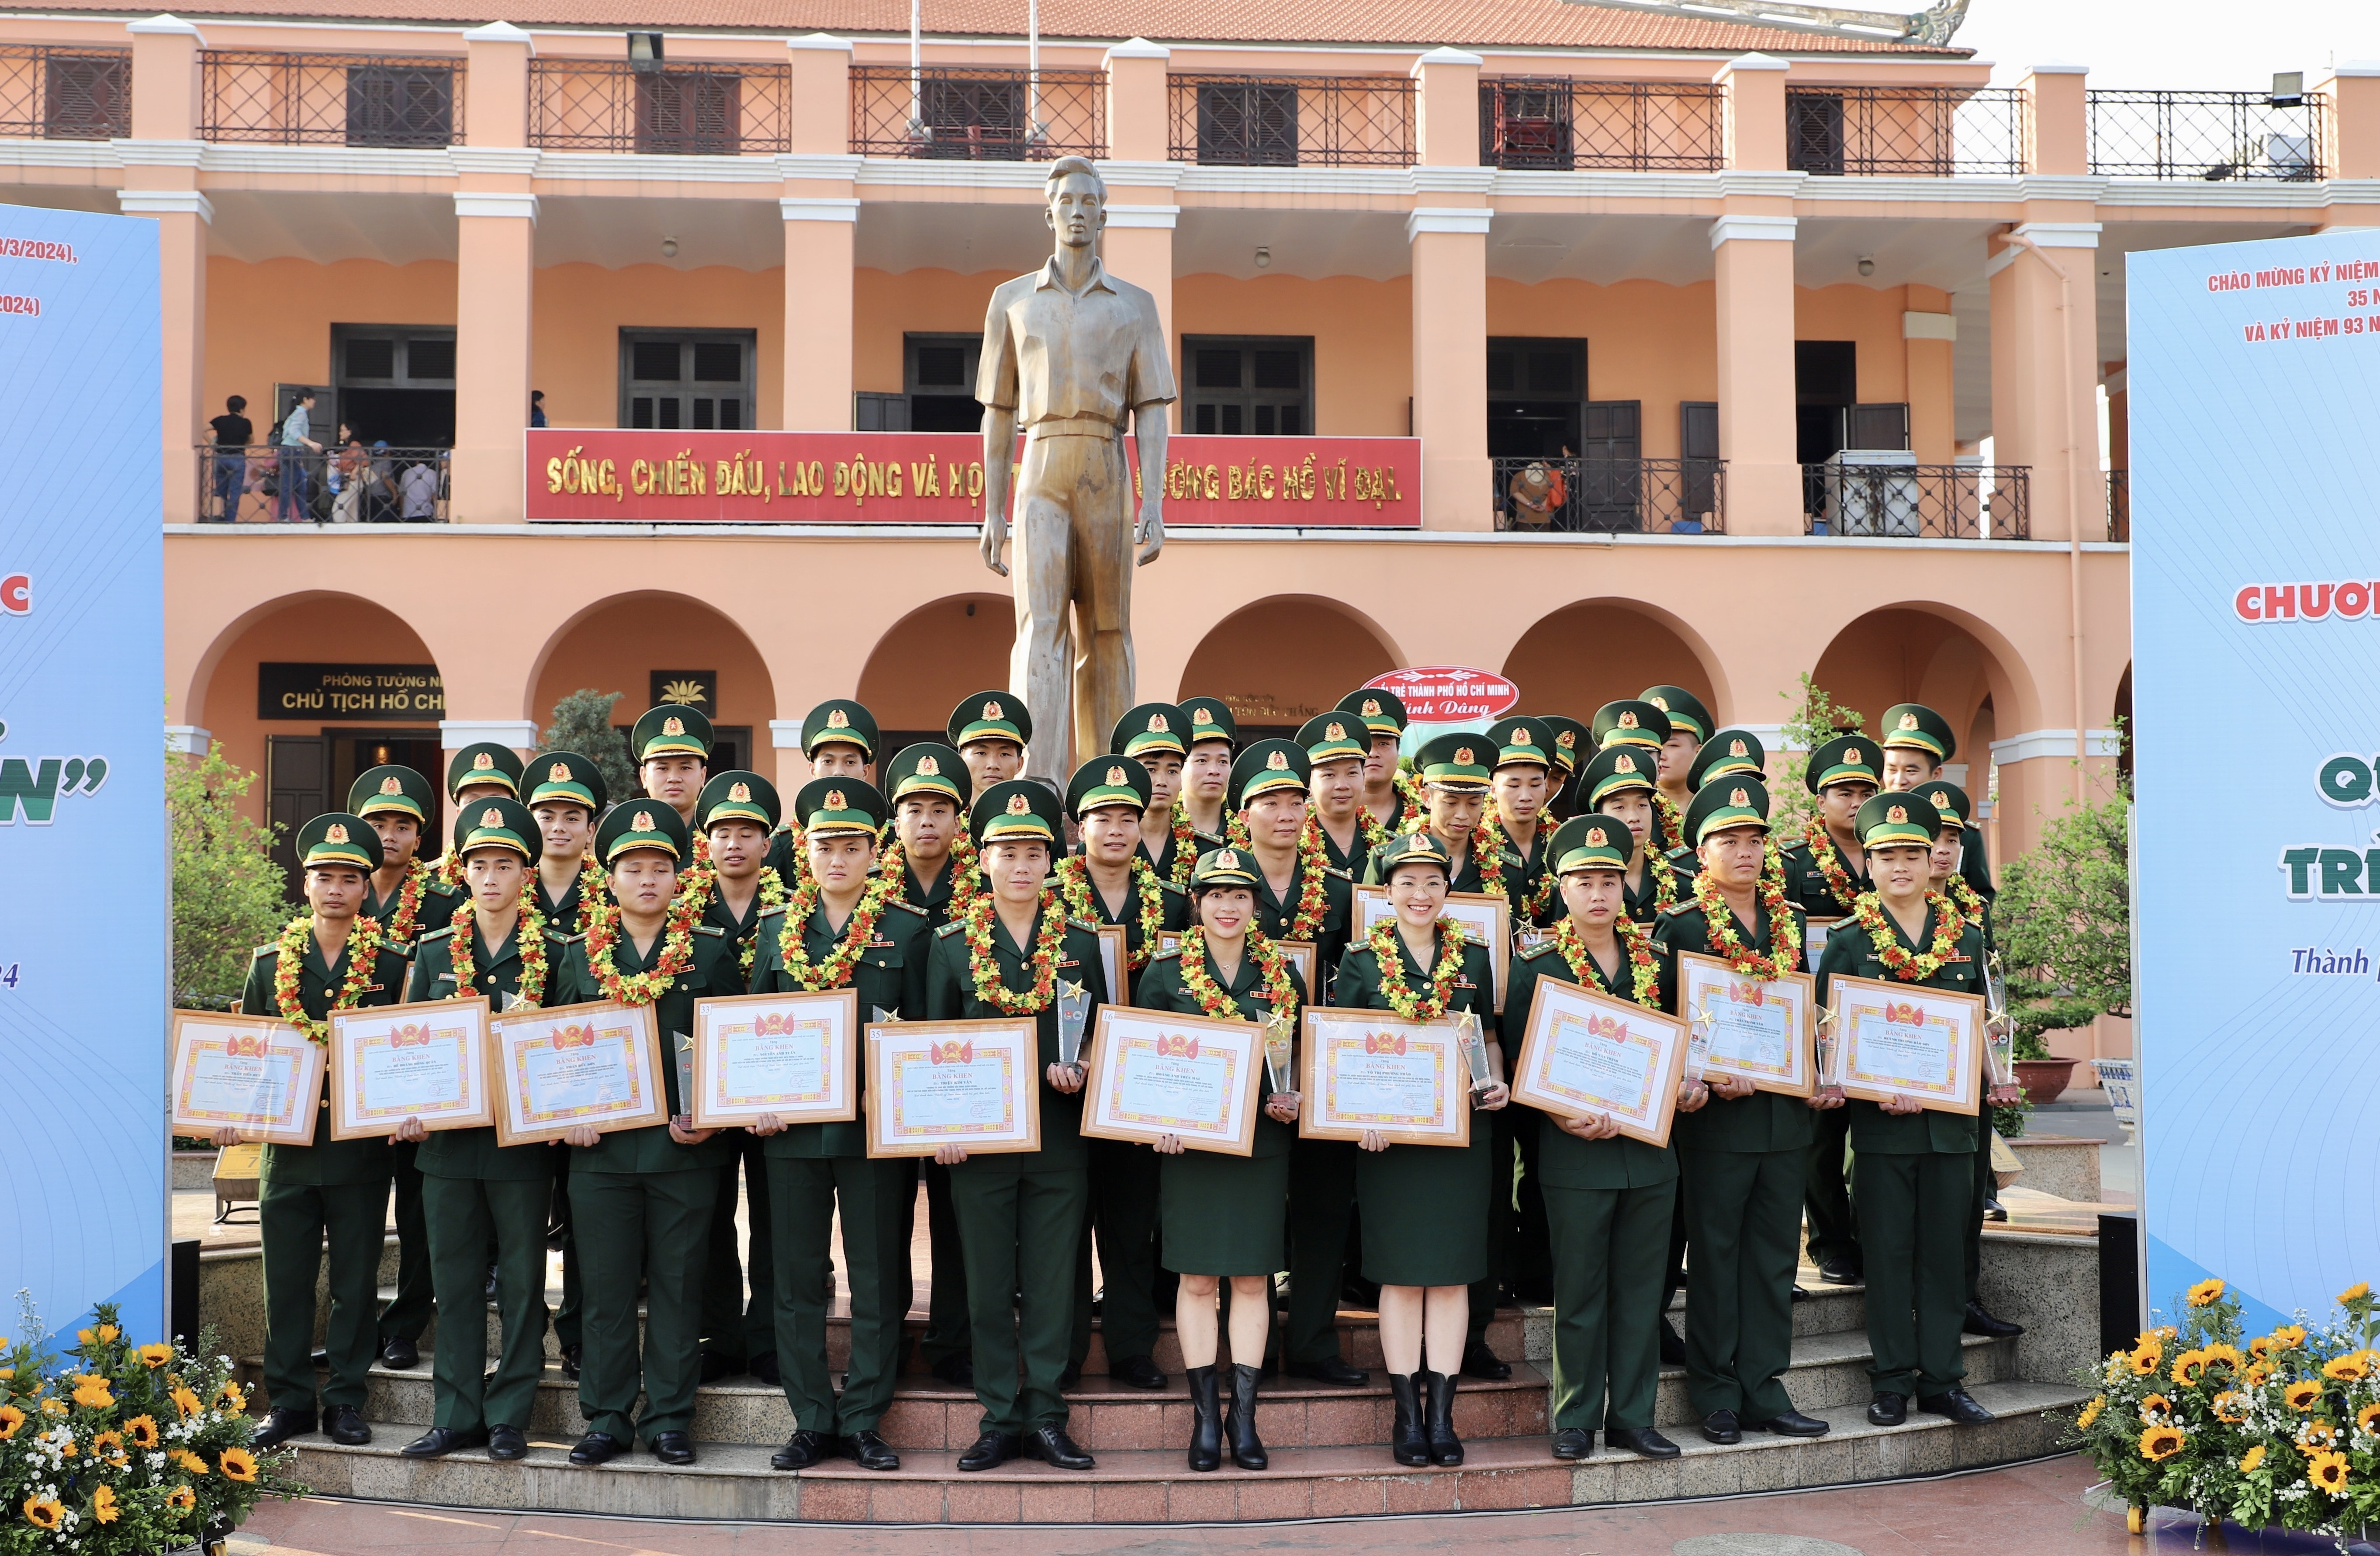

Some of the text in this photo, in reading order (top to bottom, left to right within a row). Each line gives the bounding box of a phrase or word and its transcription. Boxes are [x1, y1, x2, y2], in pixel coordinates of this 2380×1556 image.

[0, 238, 77, 263] /3/2024),
[2209, 260, 2379, 292] CHÀO MỪNG KỶ NIỆM
[0, 295, 40, 316] 024)
[2348, 290, 2367, 307] 35
[2244, 322, 2265, 342] VÀ
[2271, 317, 2290, 340] KỶ
[2296, 317, 2338, 340] NIỆM
[2344, 318, 2363, 334] 93
[547, 445, 623, 502] SỐNG,
[631, 448, 706, 496] CHIẾN
[716, 449, 771, 503] ĐẤU,
[779, 461, 824, 497] LAO
[834, 453, 903, 506] ĐỘNG
[911, 454, 941, 497] VÀ
[949, 461, 983, 507] HỌ
[1228, 457, 1275, 500] BÁC
[1283, 452, 1316, 500] HỒ
[1323, 457, 1346, 500] VĨ
[1355, 466, 1402, 510] ĐẠI.
[323, 672, 372, 687] PHÒNG
[375, 673, 426, 688] TƯỞNG
[1408, 683, 1435, 697] THÀNH
[1437, 681, 1454, 697] PHỐ
[1456, 681, 1468, 697] HỒ
[1470, 682, 1485, 697] CHÍ
[1487, 684, 1509, 696] MINH
[282, 688, 324, 709] CHỦ
[330, 693, 374, 712] TỊCH
[381, 689, 409, 710] HỒ
[1439, 700, 1491, 716] Dâng
[2320, 756, 2380, 803] Q
[2292, 948, 2369, 974] Thành
[0, 964, 18, 988] 4
[1543, 983, 1552, 991] 30
[1730, 1008, 1745, 1017] BẰNG
[1885, 1028, 1903, 1037] BẰNG
[755, 1043, 773, 1051] BẰNG
[1584, 1040, 1621, 1058] BẰNG KHEN
[392, 1053, 410, 1062] BẰNG
[556, 1055, 575, 1064] BẰNG
[224, 1062, 243, 1070] BẰNG
[1155, 1062, 1175, 1071] BẰNG
[932, 1071, 951, 1079] BẰNG
